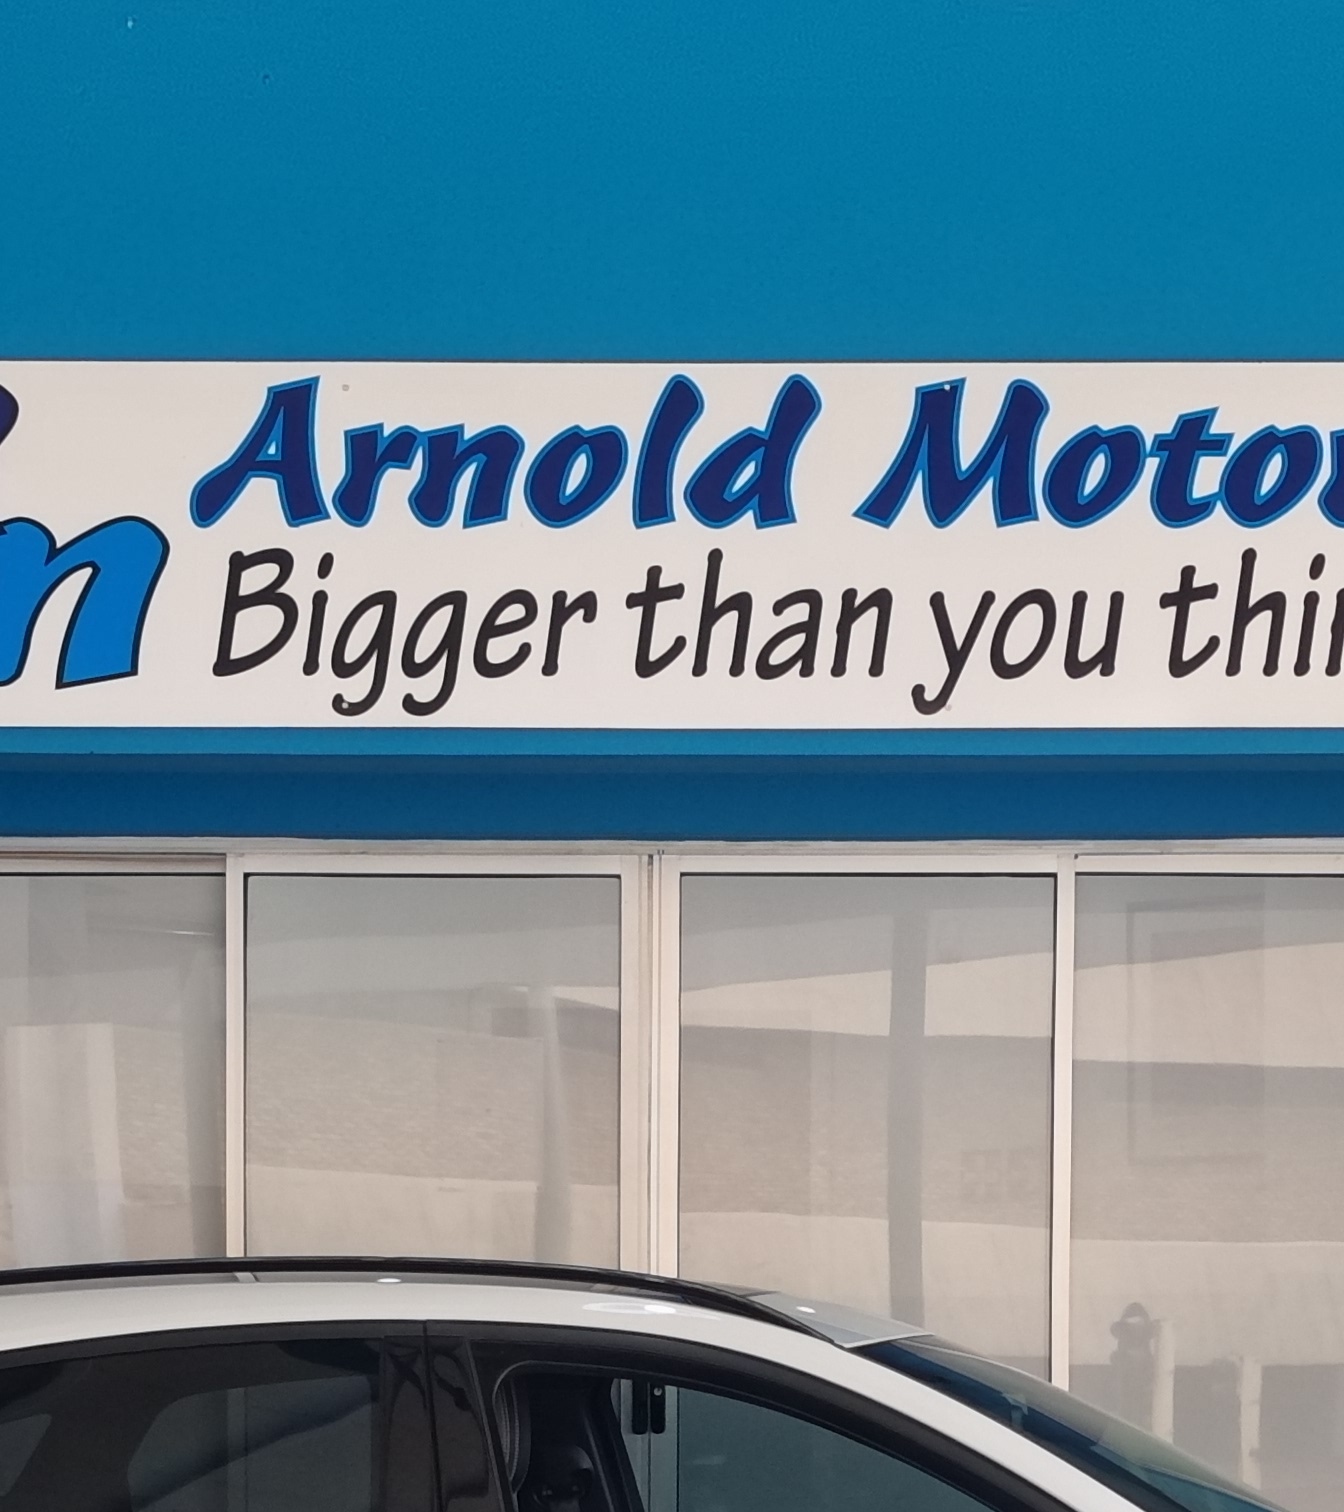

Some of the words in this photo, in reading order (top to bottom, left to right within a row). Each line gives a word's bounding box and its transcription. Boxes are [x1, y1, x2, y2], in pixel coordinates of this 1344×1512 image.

[189, 373, 822, 529] Arnold
[212, 547, 598, 718] Bigger
[625, 547, 894, 681] than
[910, 588, 1125, 716] you
